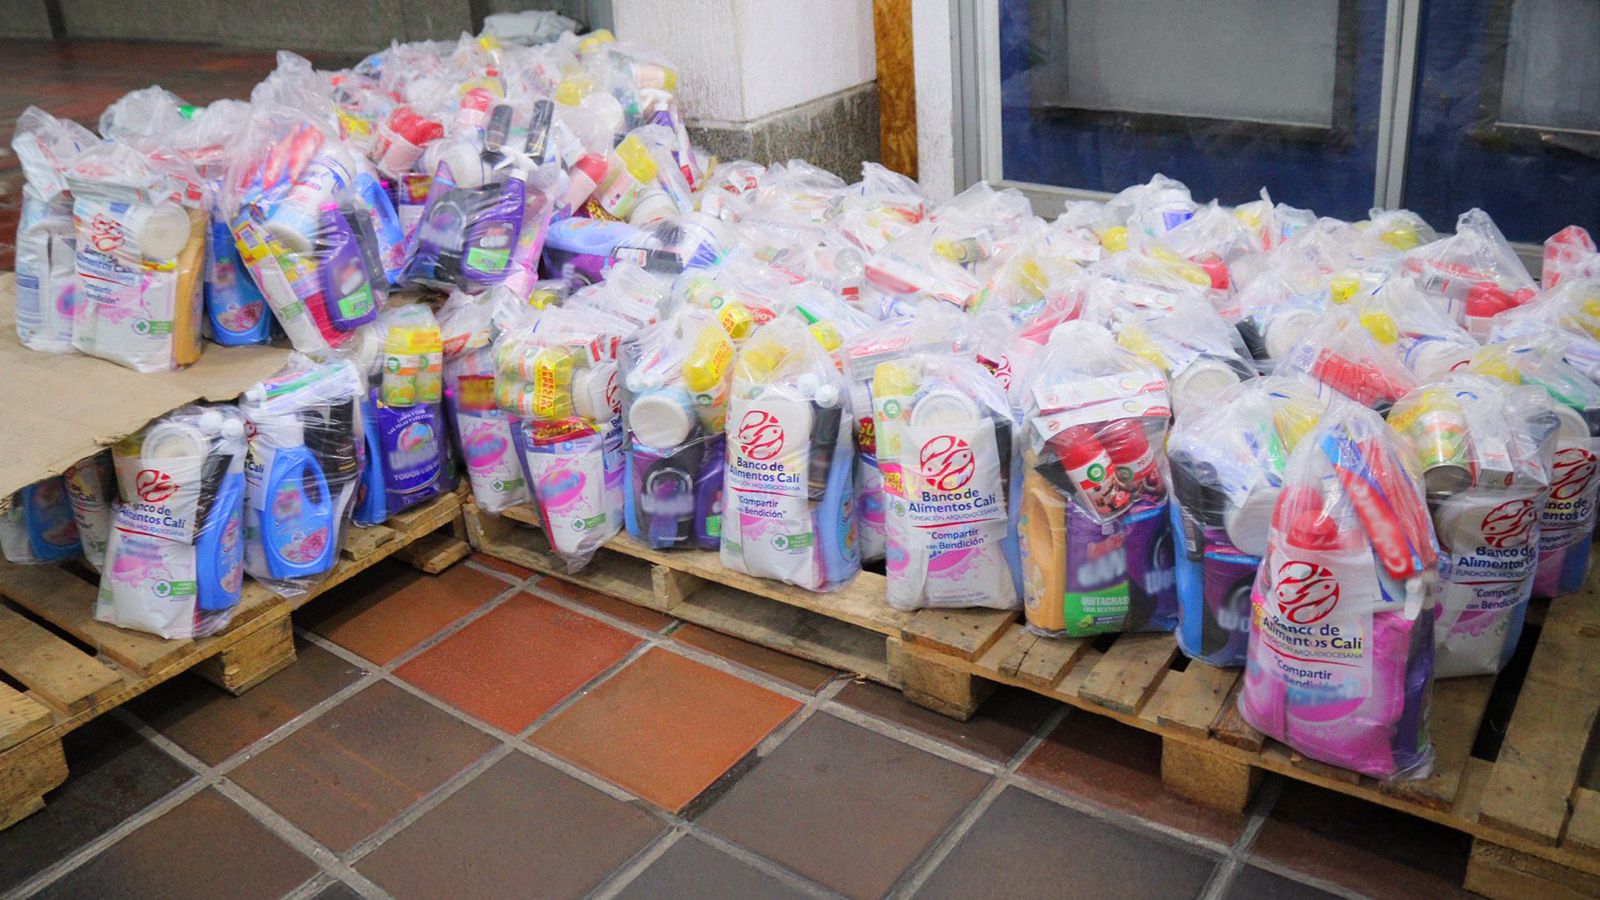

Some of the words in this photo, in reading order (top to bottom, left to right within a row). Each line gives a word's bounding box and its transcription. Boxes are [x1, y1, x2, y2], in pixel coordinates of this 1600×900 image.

[737, 456, 768, 471] Banco
[769, 461, 784, 472] de
[777, 473, 800, 483] Cali
[922, 491, 962, 502] Banco
[964, 488, 979, 499] de
[909, 502, 971, 514] Alimentos
[973, 493, 996, 508] Cali
[157, 505, 171, 516] de
[163, 516, 186, 528] Cali
[1476, 546, 1519, 558] Banco
[1458, 557, 1524, 569] Alimentos
[1320, 623, 1340, 636] de
[1331, 637, 1362, 650] Cali
